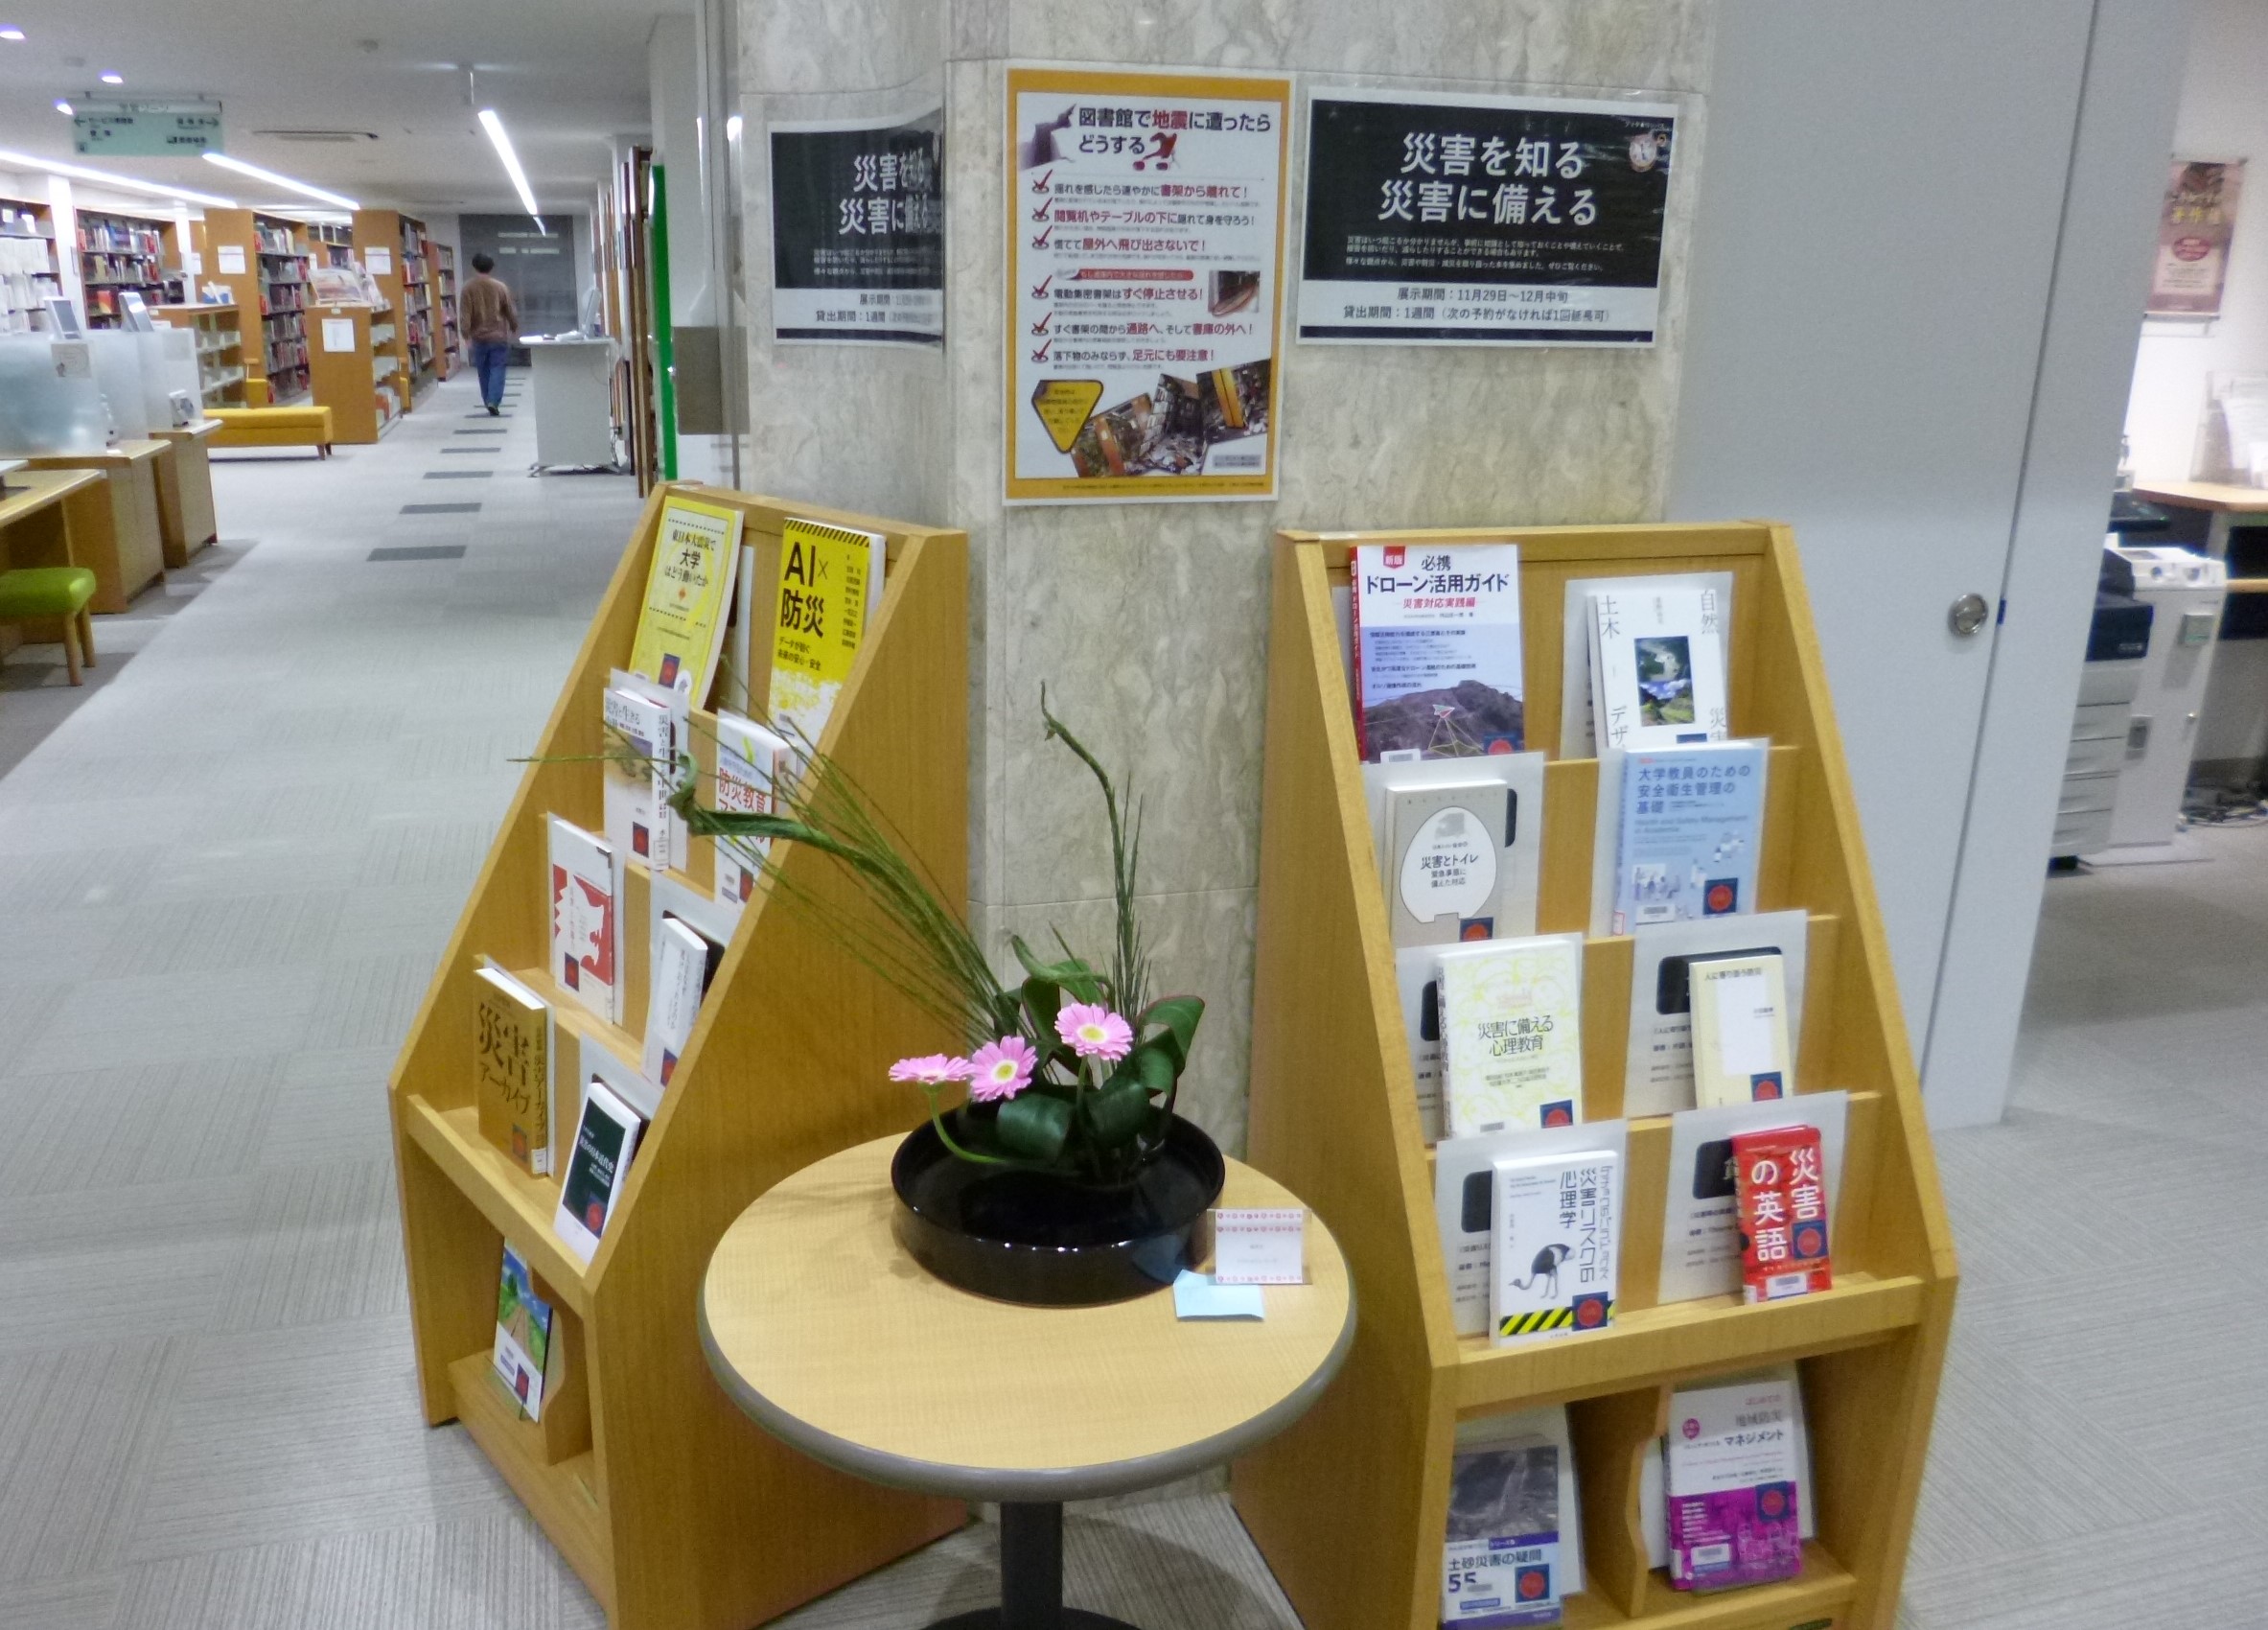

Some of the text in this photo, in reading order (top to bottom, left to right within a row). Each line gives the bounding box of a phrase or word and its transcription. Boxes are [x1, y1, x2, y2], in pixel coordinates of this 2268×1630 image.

[1079, 107, 1271, 132] 図書館で地震に遭ったら
[853, 147, 924, 192] 災害を
[1400, 131, 1585, 178] 災害を知る
[839, 193, 929, 235] 災害に
[1377, 179, 1598, 227] 災害に備える
[680, 548, 701, 569] 大学
[1421, 554, 1451, 571] 必携
[1367, 573, 1510, 594] ドローン活用ガイド
[779, 588, 825, 640] 防災
[1701, 590, 1719, 635] 自然
[1599, 595, 1629, 746] 土木 デザ
[1638, 765, 1750, 781] 大学教員のための
[1420, 852, 1478, 870] 災害とトイレ
[1478, 1014, 1554, 1040] 災害に備える
[1489, 1035, 1544, 1057] 心理教育
[1560, 1170, 1577, 1229] 心理学
[1789, 1148, 1821, 1220] 災害
[1580, 1167, 1597, 1283] 災害リスクの
[1751, 1159, 1788, 1262] の英語
[1724, 1429, 1784, 1446] マネジメント
